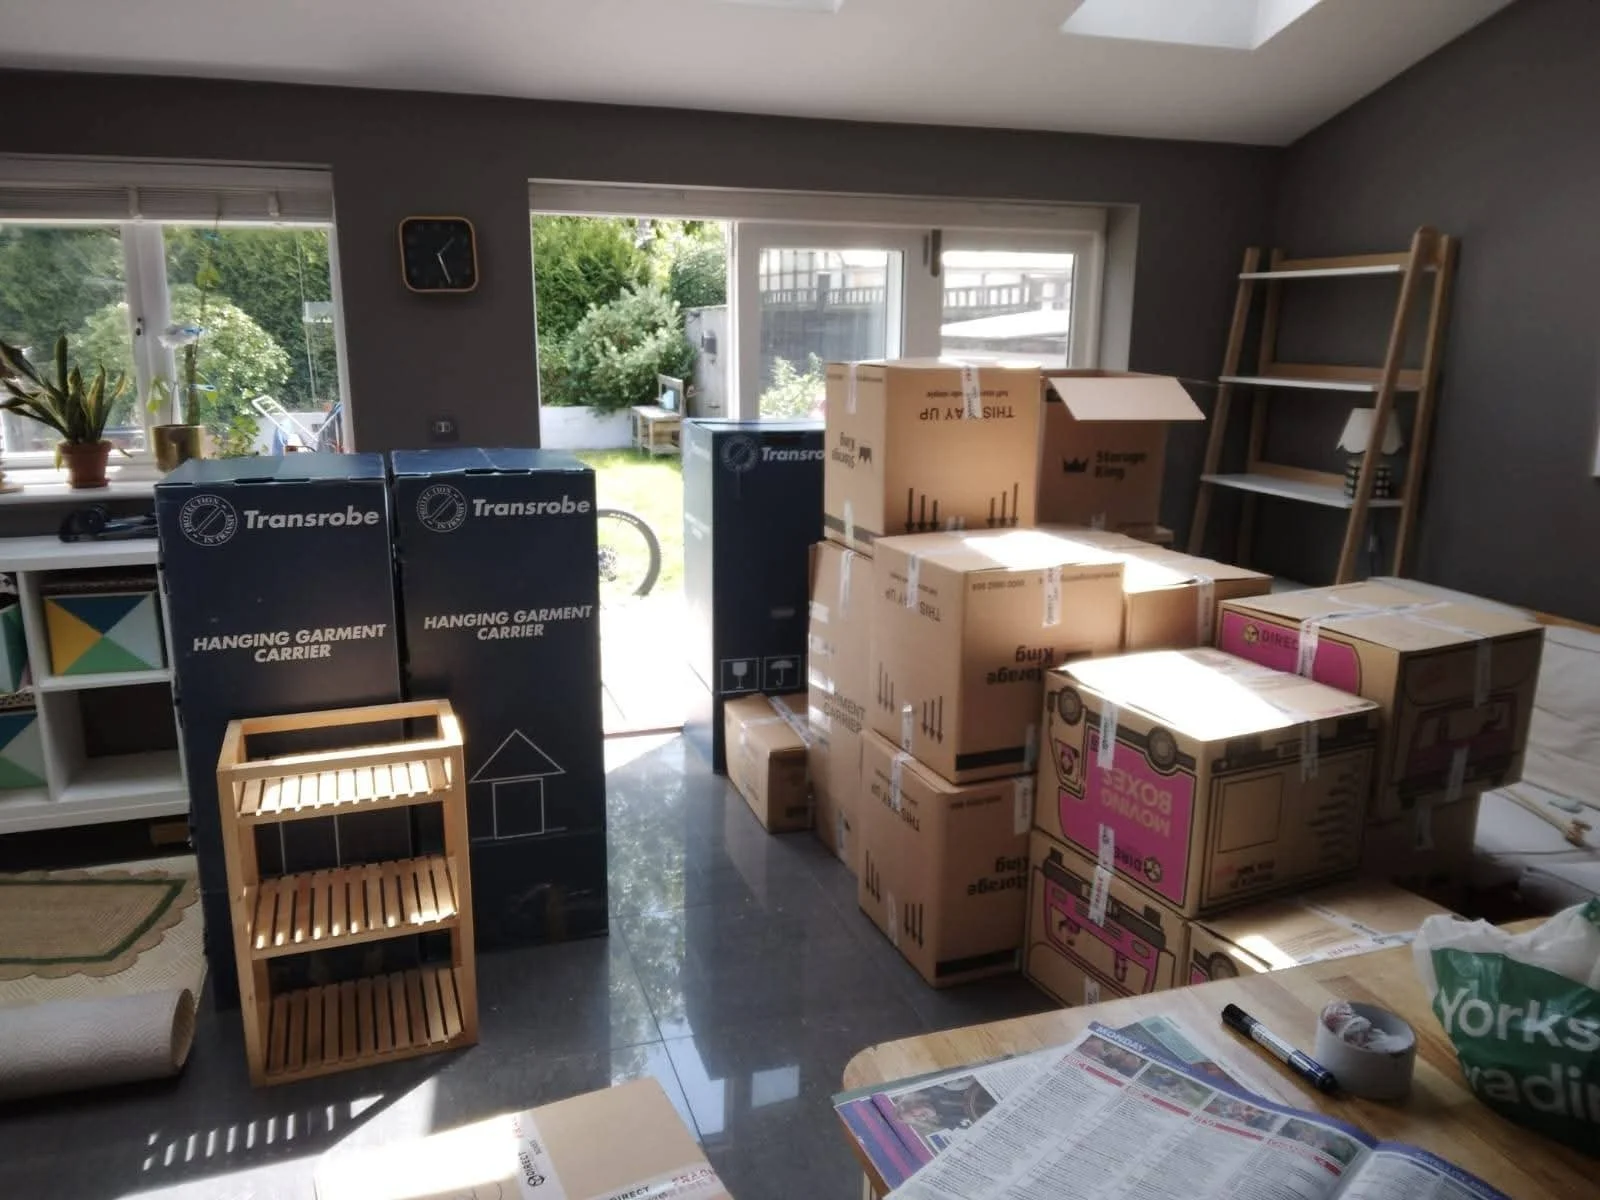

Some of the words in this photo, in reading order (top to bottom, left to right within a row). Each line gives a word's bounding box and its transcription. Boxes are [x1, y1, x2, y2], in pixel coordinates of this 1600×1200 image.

[919, 408, 940, 421] UP
[983, 406, 1015, 419] THIS
[760, 446, 825, 462] Transro
[473, 495, 591, 517] Transrobe
[243, 505, 380, 529] Transrobe
[424, 610, 509, 630] HANGING
[514, 605, 592, 624] GARMENT
[193, 631, 290, 651] HANGING
[296, 624, 386, 644] GARMENT
[477, 623, 544, 641] CARRIER
[1261, 630, 1299, 649] DIREC
[254, 644, 331, 663] CARRIER
[986, 667, 1042, 685] torage
[1103, 768, 1173, 815] BOXES
[1101, 788, 1171, 837] MOVING
[1464, 1059, 1600, 1124] radi
